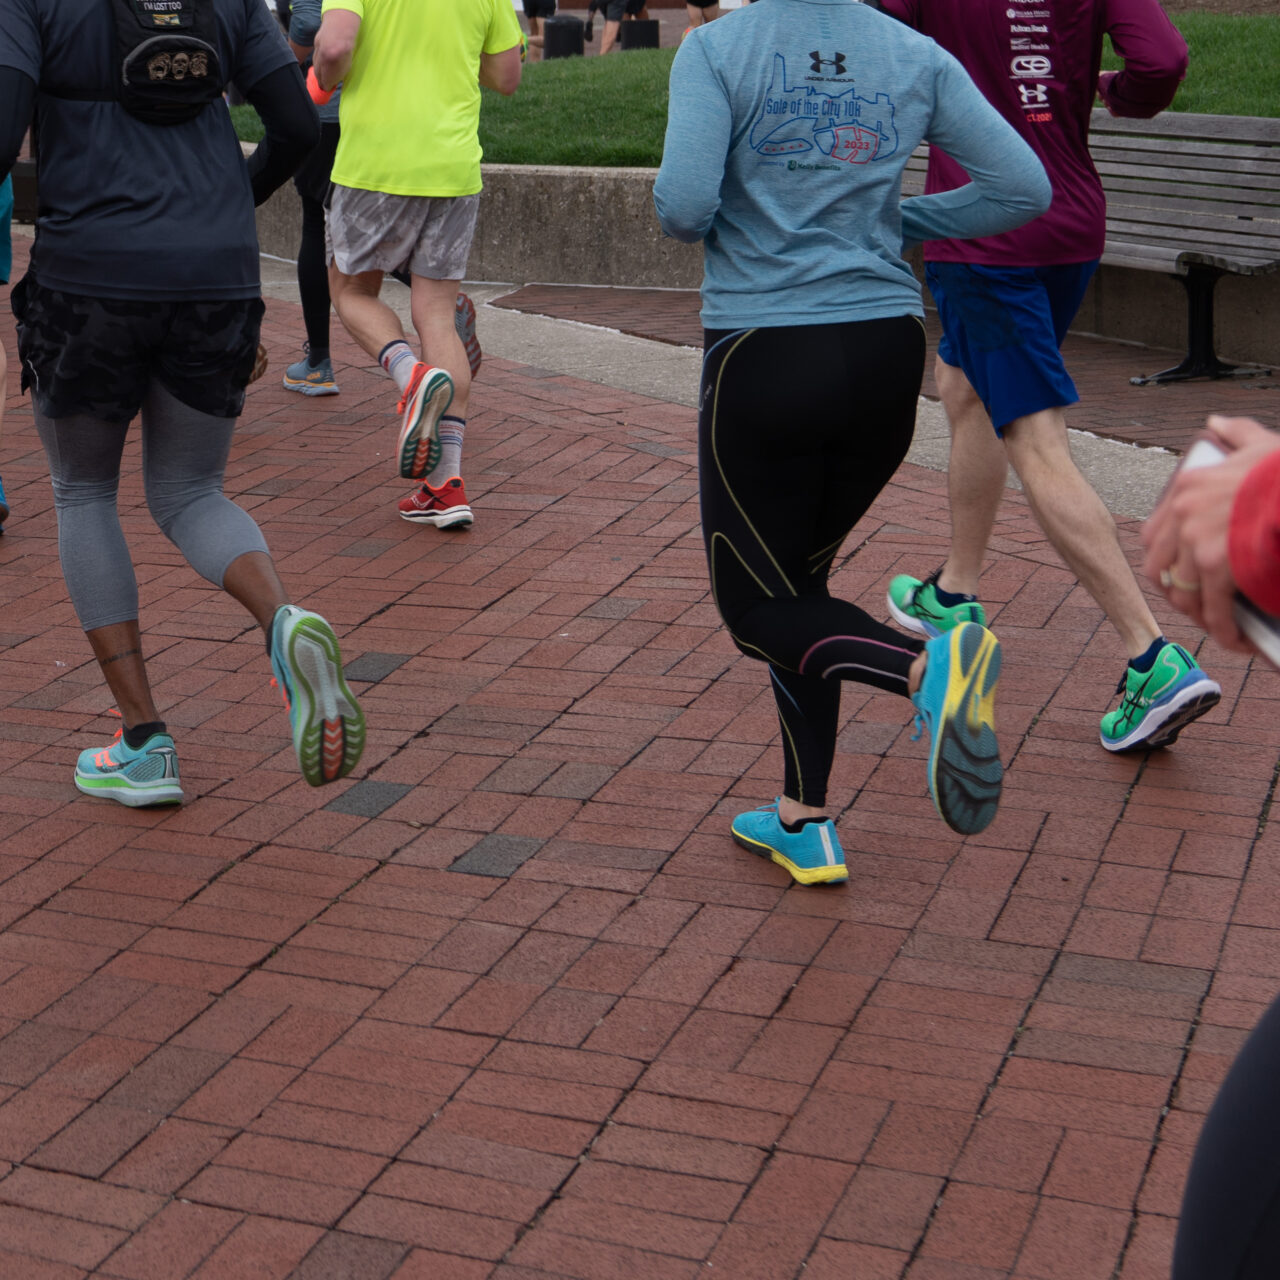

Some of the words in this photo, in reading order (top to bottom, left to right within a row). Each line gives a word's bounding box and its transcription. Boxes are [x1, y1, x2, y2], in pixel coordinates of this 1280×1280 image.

[169, 2, 181, 10] TOO
[767, 98, 787, 115] Sole
[790, 98, 803, 116] of
[804, 99, 819, 116] the
[822, 99, 840, 119] City
[843, 140, 870, 150] 2023
